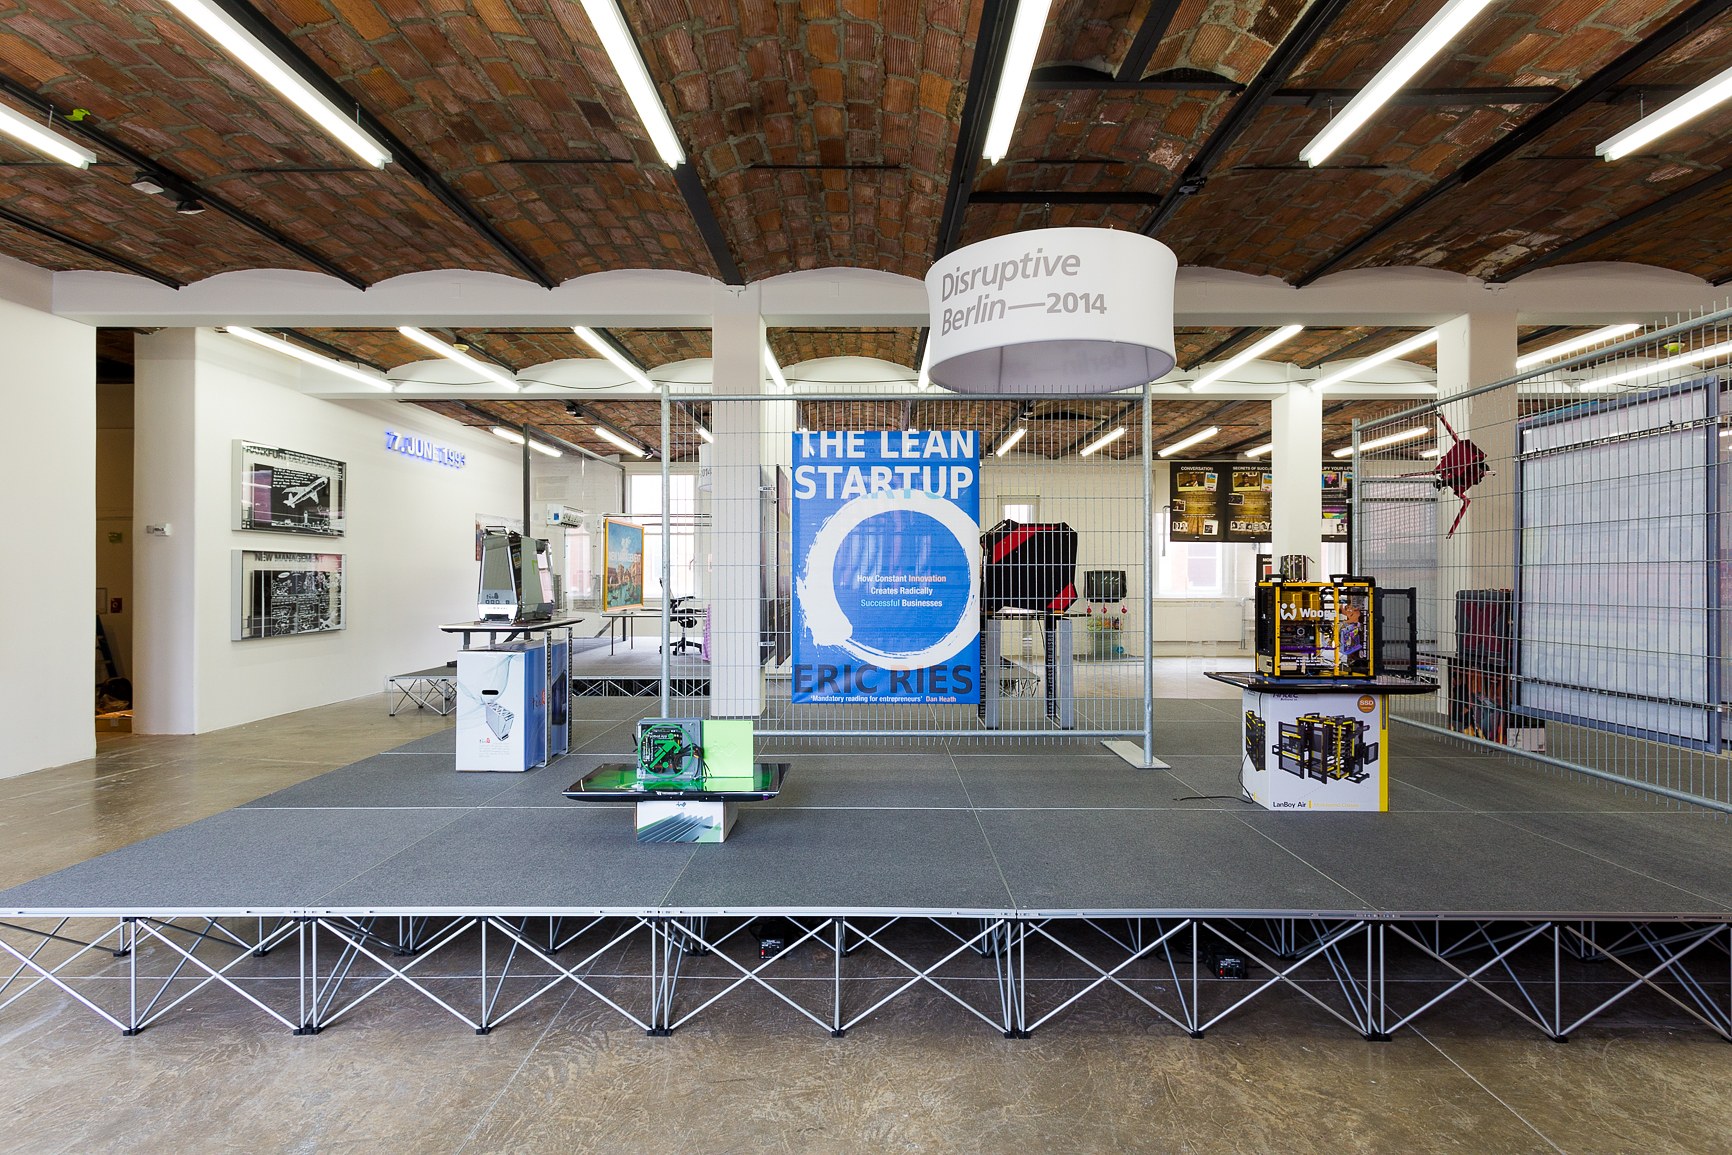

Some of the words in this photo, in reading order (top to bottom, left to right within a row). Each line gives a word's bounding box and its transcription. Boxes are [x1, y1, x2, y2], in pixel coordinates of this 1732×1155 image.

[942, 248, 1081, 302] Disruptive
[404, 437, 440, 461] JUNE
[794, 430, 866, 458] THE
[881, 430, 974, 458] LEAN
[794, 465, 974, 499] STARTUP
[254, 553, 273, 562] NEW
[875, 574, 907, 582] Constant
[909, 574, 947, 582] Innovation
[900, 587, 933, 596] Radically
[861, 599, 900, 607] Successful
[902, 599, 943, 607] Businesses
[794, 664, 878, 694] ERIC
[890, 664, 974, 694] RIES
[846, 695, 868, 703] reading
